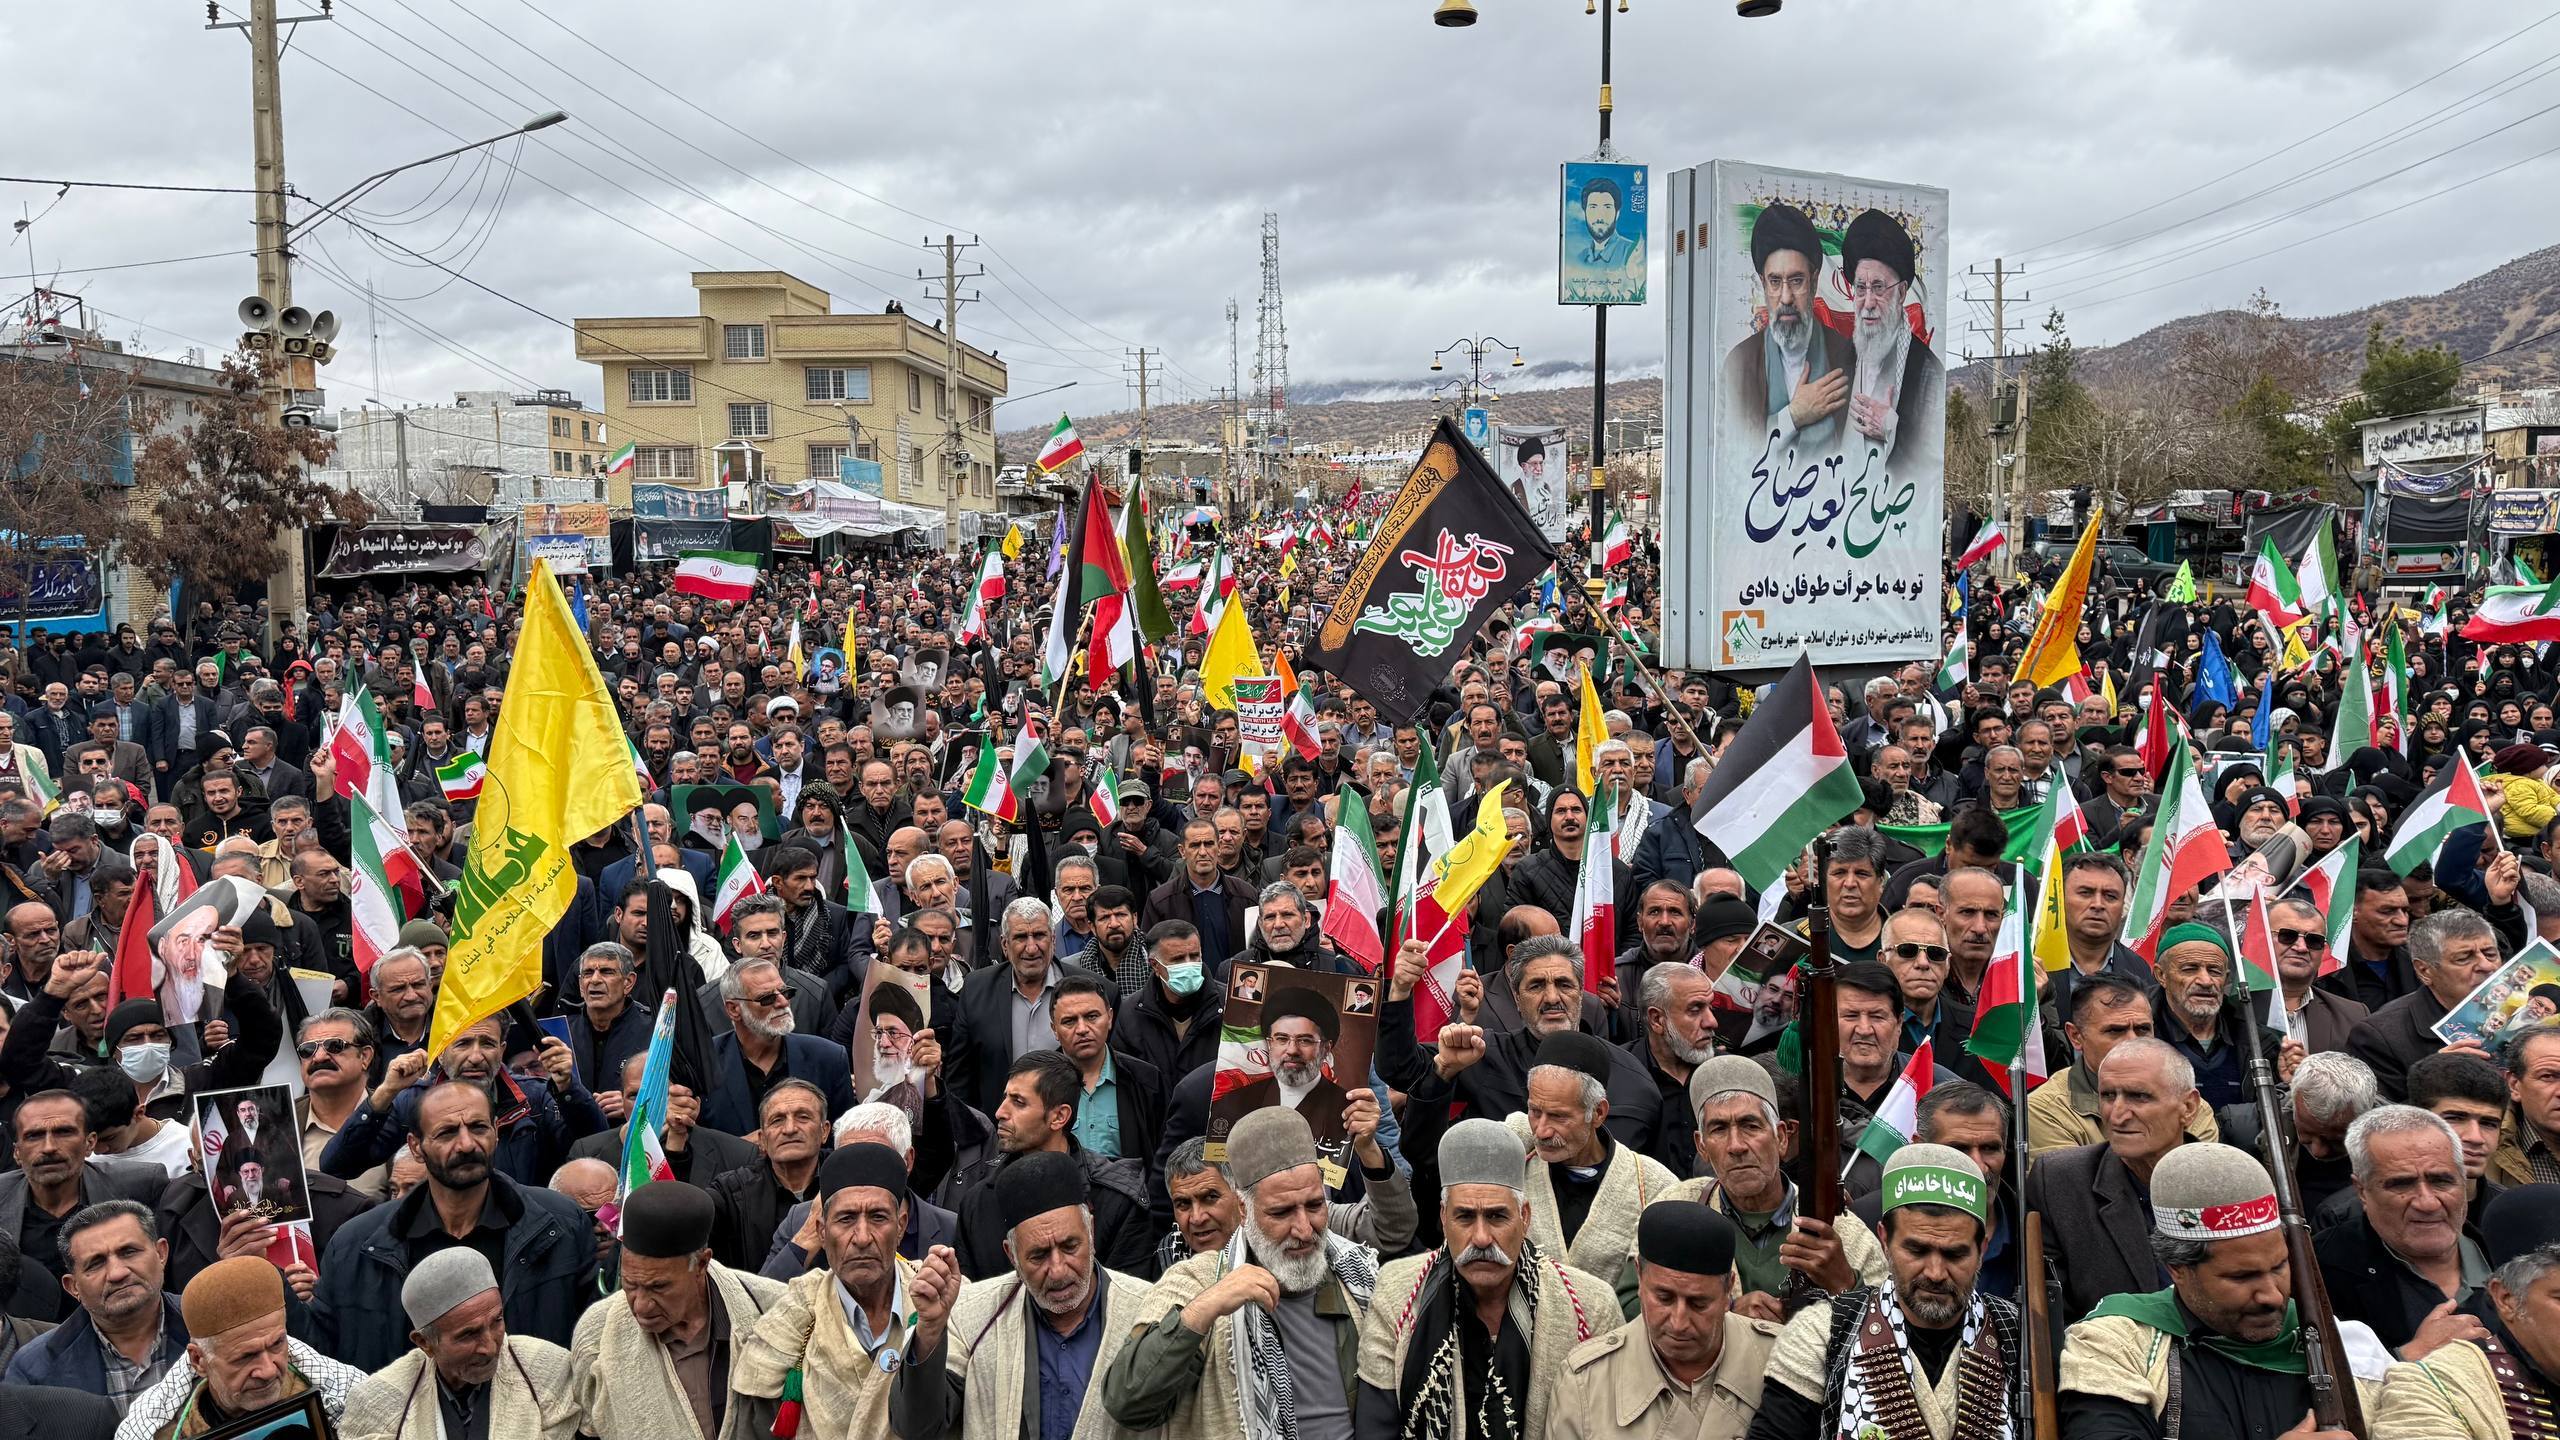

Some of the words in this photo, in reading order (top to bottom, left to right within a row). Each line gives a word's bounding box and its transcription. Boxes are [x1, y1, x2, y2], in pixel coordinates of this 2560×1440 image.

[2381, 429, 2408, 452] لاهوری
[2408, 421, 2428, 448] اقبال
[2427, 423, 2444, 445] فنی
[2443, 418, 2481, 442] هنرستان
[1745, 428, 1819, 543] صالح
[1843, 448, 1916, 558] صالح
[1537, 511, 1557, 527] ایران
[353, 537, 389, 556] الشهداء
[409, 537, 438, 555] حضرت
[438, 537, 463, 554] موکب
[1739, 575, 1779, 606] دادی
[1782, 573, 1830, 604] طوفان
[1833, 570, 1873, 603] جرأت
[1875, 573, 1889, 595] ما
[1892, 580, 1906, 602] به
[1908, 573, 1923, 602] تو
[1761, 632, 1784, 650] یاسوج
[1786, 632, 1799, 649] شهر
[1826, 629, 1849, 647] شورای
[1851, 637, 1856, 646] و
[1856, 628, 1888, 645] شهرداری
[1888, 631, 1913, 644] عمومی
[1914, 626, 1934, 643] روابط
[1238, 705, 1257, 717] آمریکا
[1258, 709, 1265, 717] بر
[1265, 705, 1282, 717] مرگ
[1261, 728, 1267, 736] بر
[533, 856, 567, 896] المقاومة
[483, 932, 496, 956] في
[459, 948, 482, 975] لبنان
[1942, 1174, 1953, 1200] یا
[1952, 1180, 1976, 1207] لبیک
